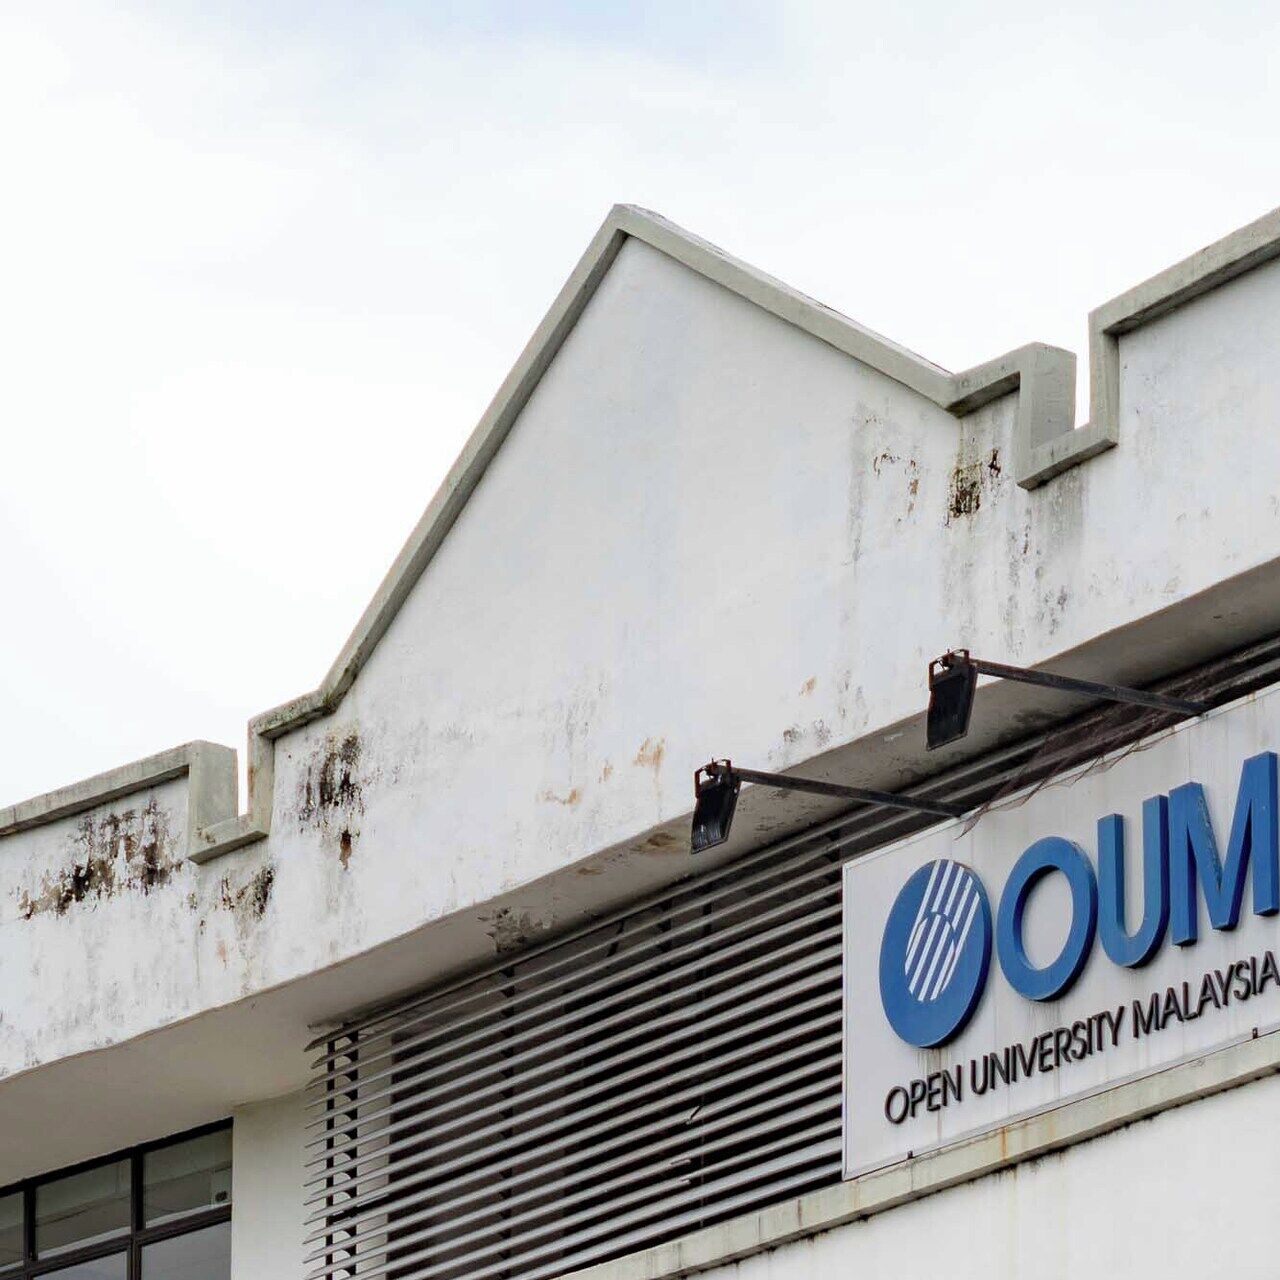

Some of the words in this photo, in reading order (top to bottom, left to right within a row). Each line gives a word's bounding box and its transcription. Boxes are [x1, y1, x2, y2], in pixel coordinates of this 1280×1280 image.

[995, 751, 1280, 1002] OUM
[884, 1064, 961, 1124] OPEN
[970, 1006, 1124, 1096] UNIVERSITY
